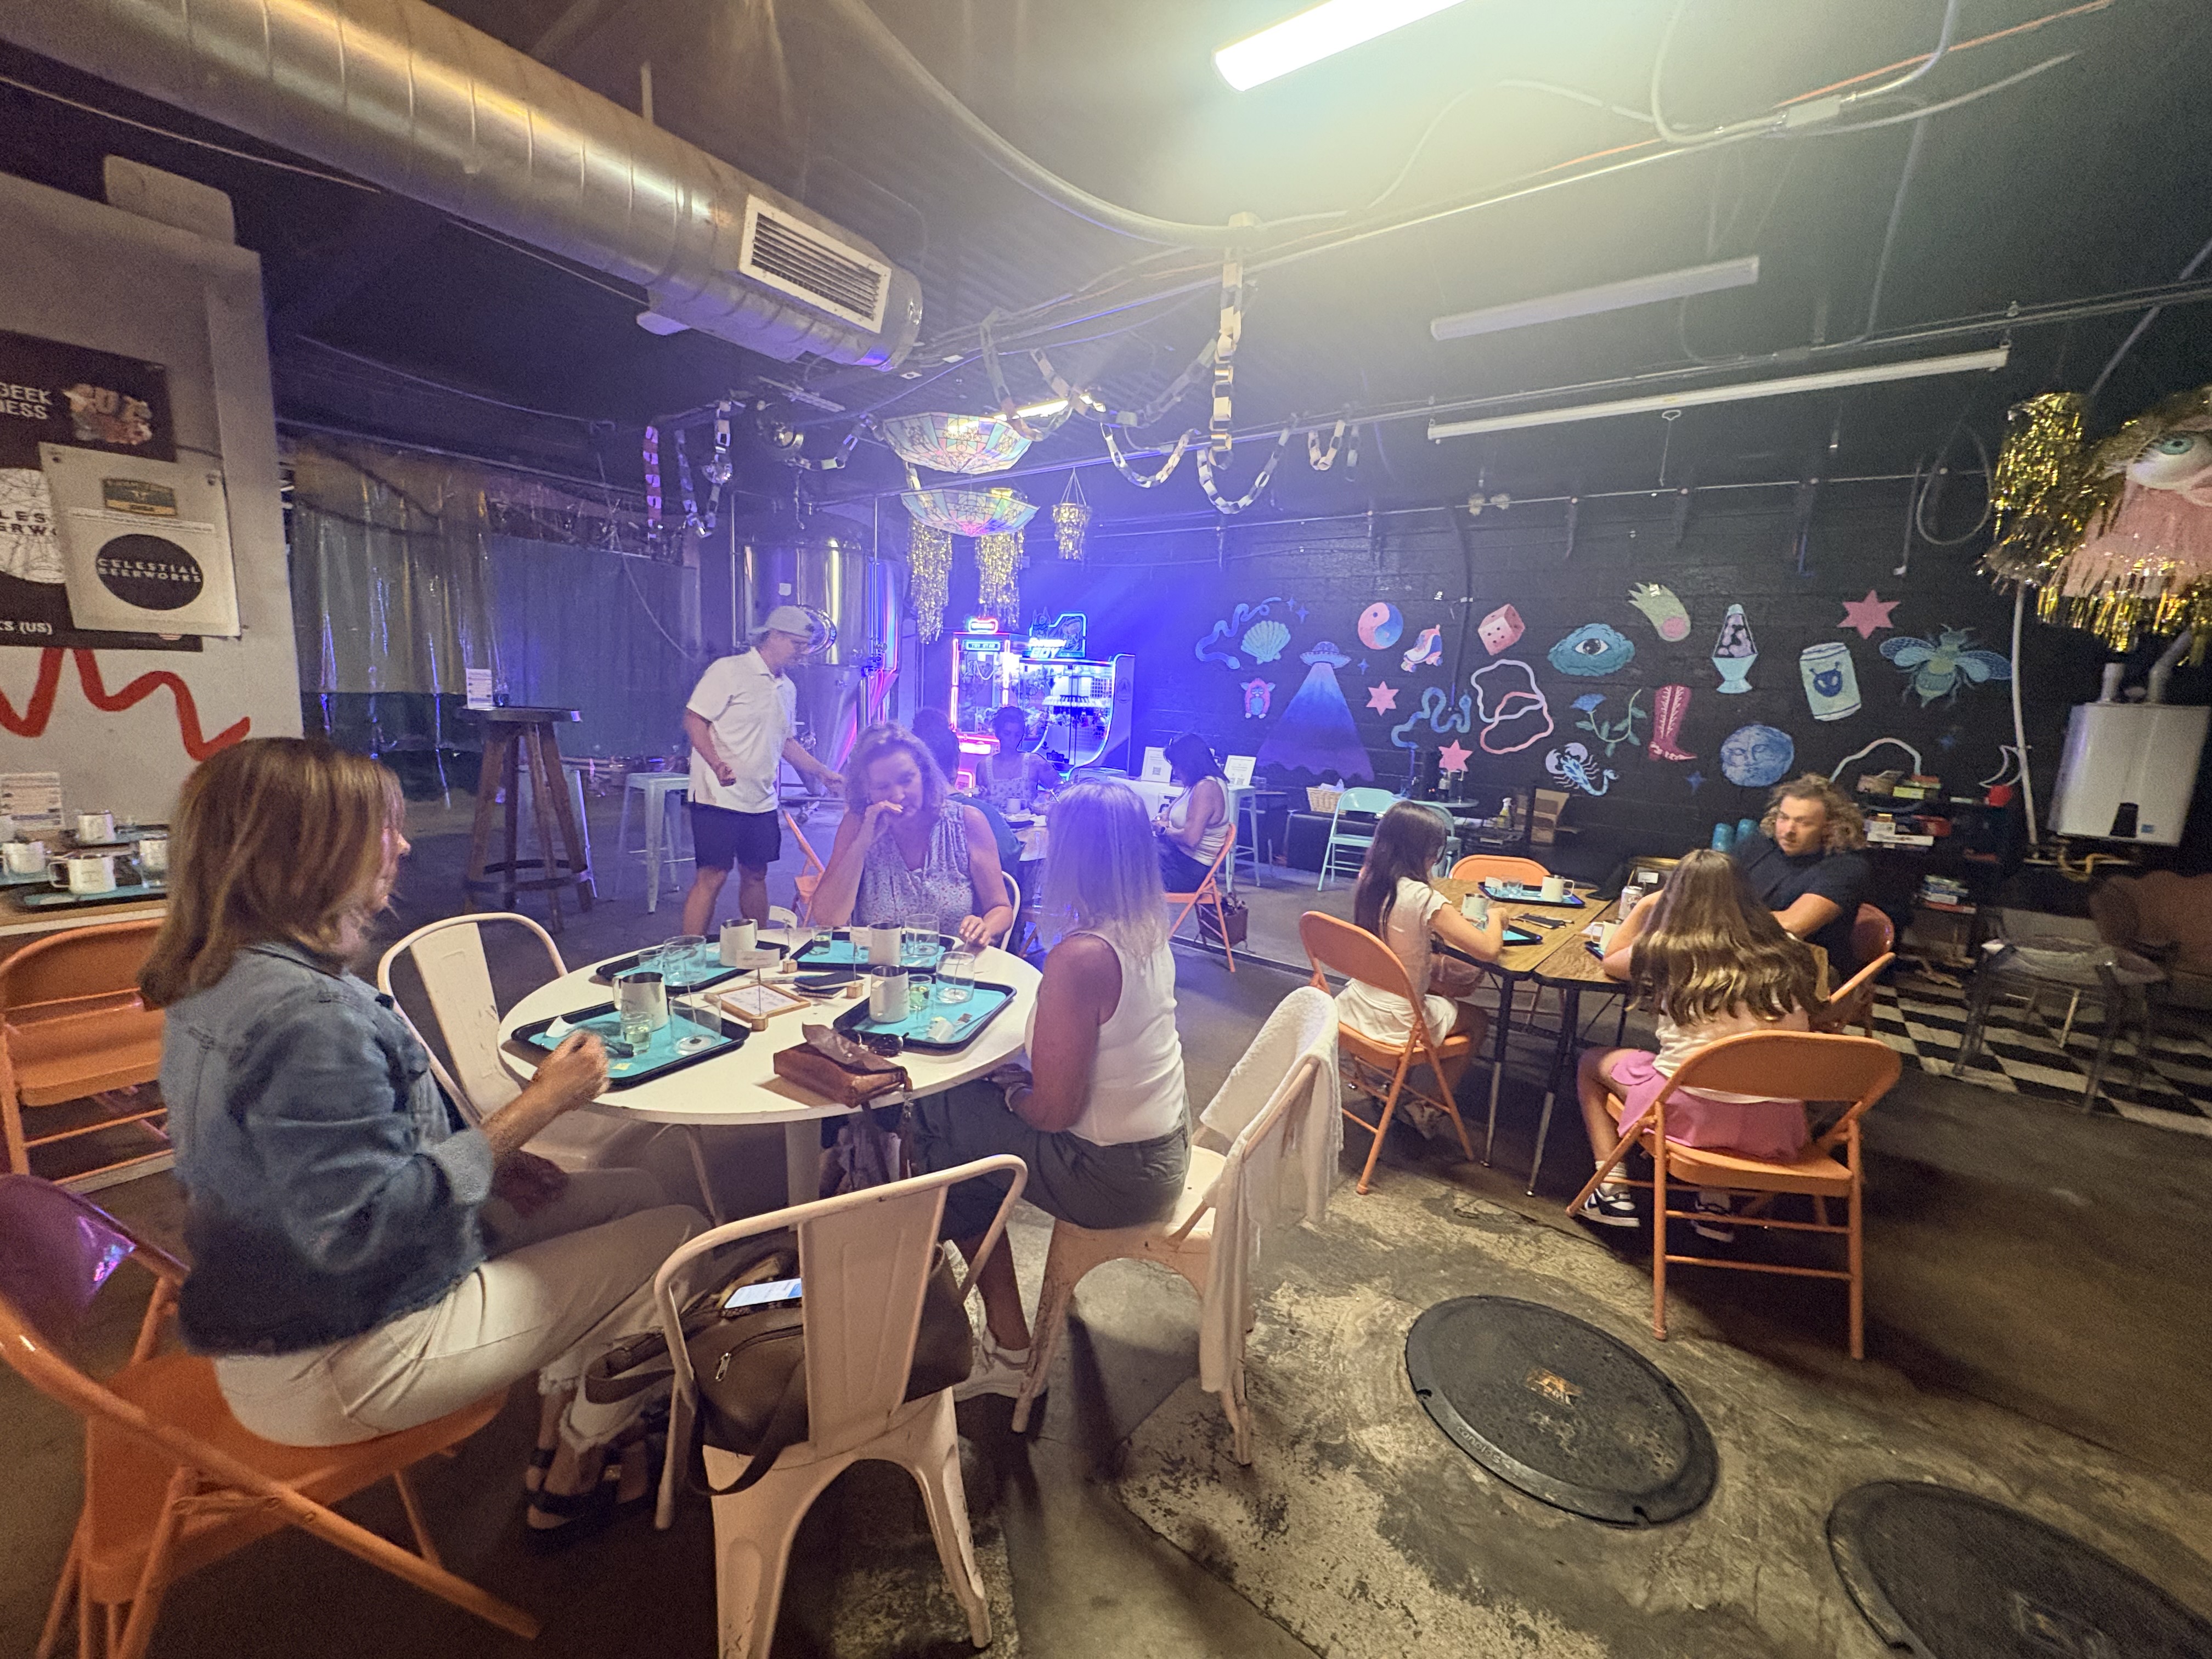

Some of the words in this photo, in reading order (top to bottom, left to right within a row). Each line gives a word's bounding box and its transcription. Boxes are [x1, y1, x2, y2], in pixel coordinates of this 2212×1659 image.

[97, 558, 199, 574] CELESTIAL
[98, 567, 201, 583] BEERWORKS
[19, 621, 53, 635] (US)
[1029, 647, 1060, 658] BOY
